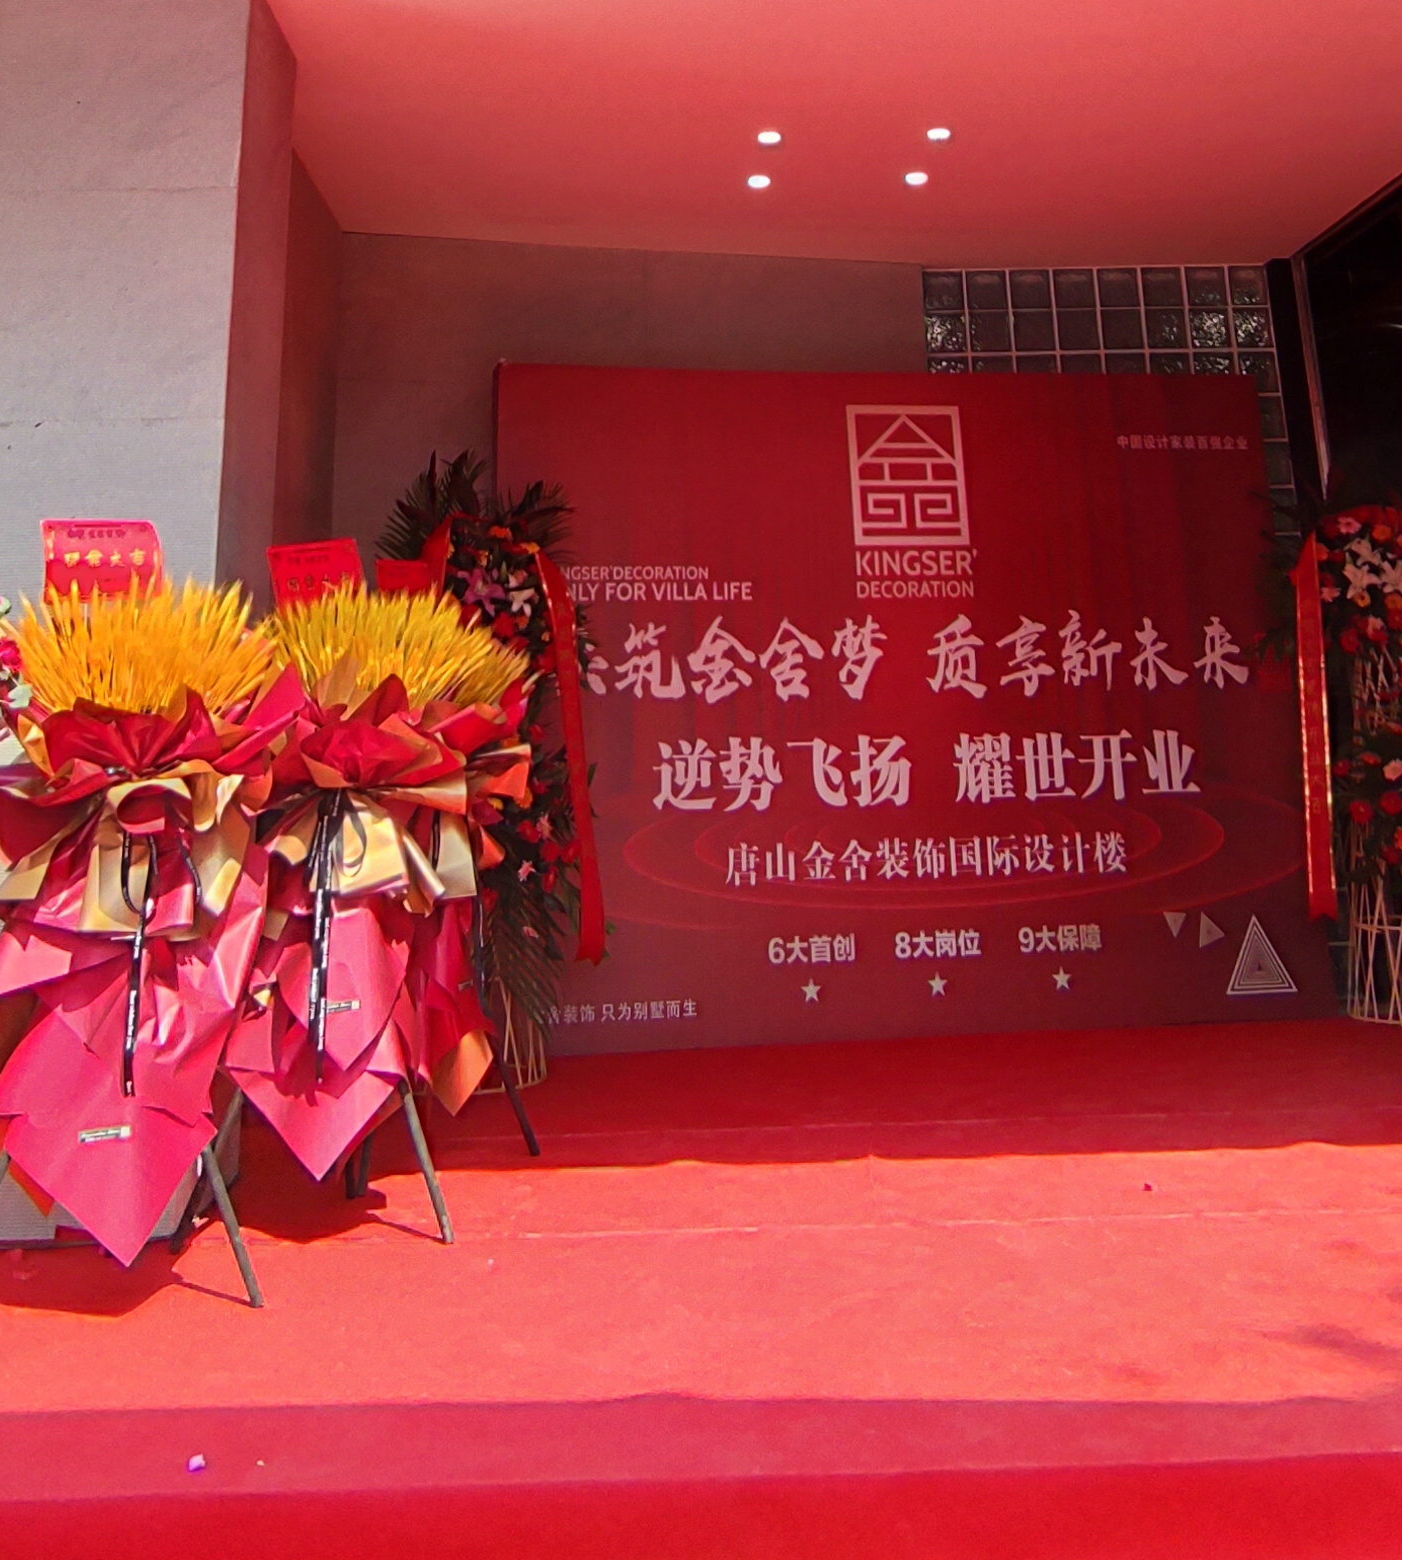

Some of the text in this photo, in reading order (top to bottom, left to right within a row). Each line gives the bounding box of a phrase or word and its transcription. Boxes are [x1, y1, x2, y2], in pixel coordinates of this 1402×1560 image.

[605, 582, 648, 602] FOR
[650, 581, 708, 602] VILLA
[712, 581, 753, 601] LIFE
[856, 579, 975, 599] DECORATION
[925, 608, 1250, 699] 质享新未来
[652, 727, 1202, 812] 逆势飞扬 耀世开业
[724, 830, 1128, 887] 唐山金舍装饰国际设计楼
[767, 922, 1103, 965] 6大首创 8大岗位 9大保障
[600, 997, 698, 1022] 只为别墅而生
